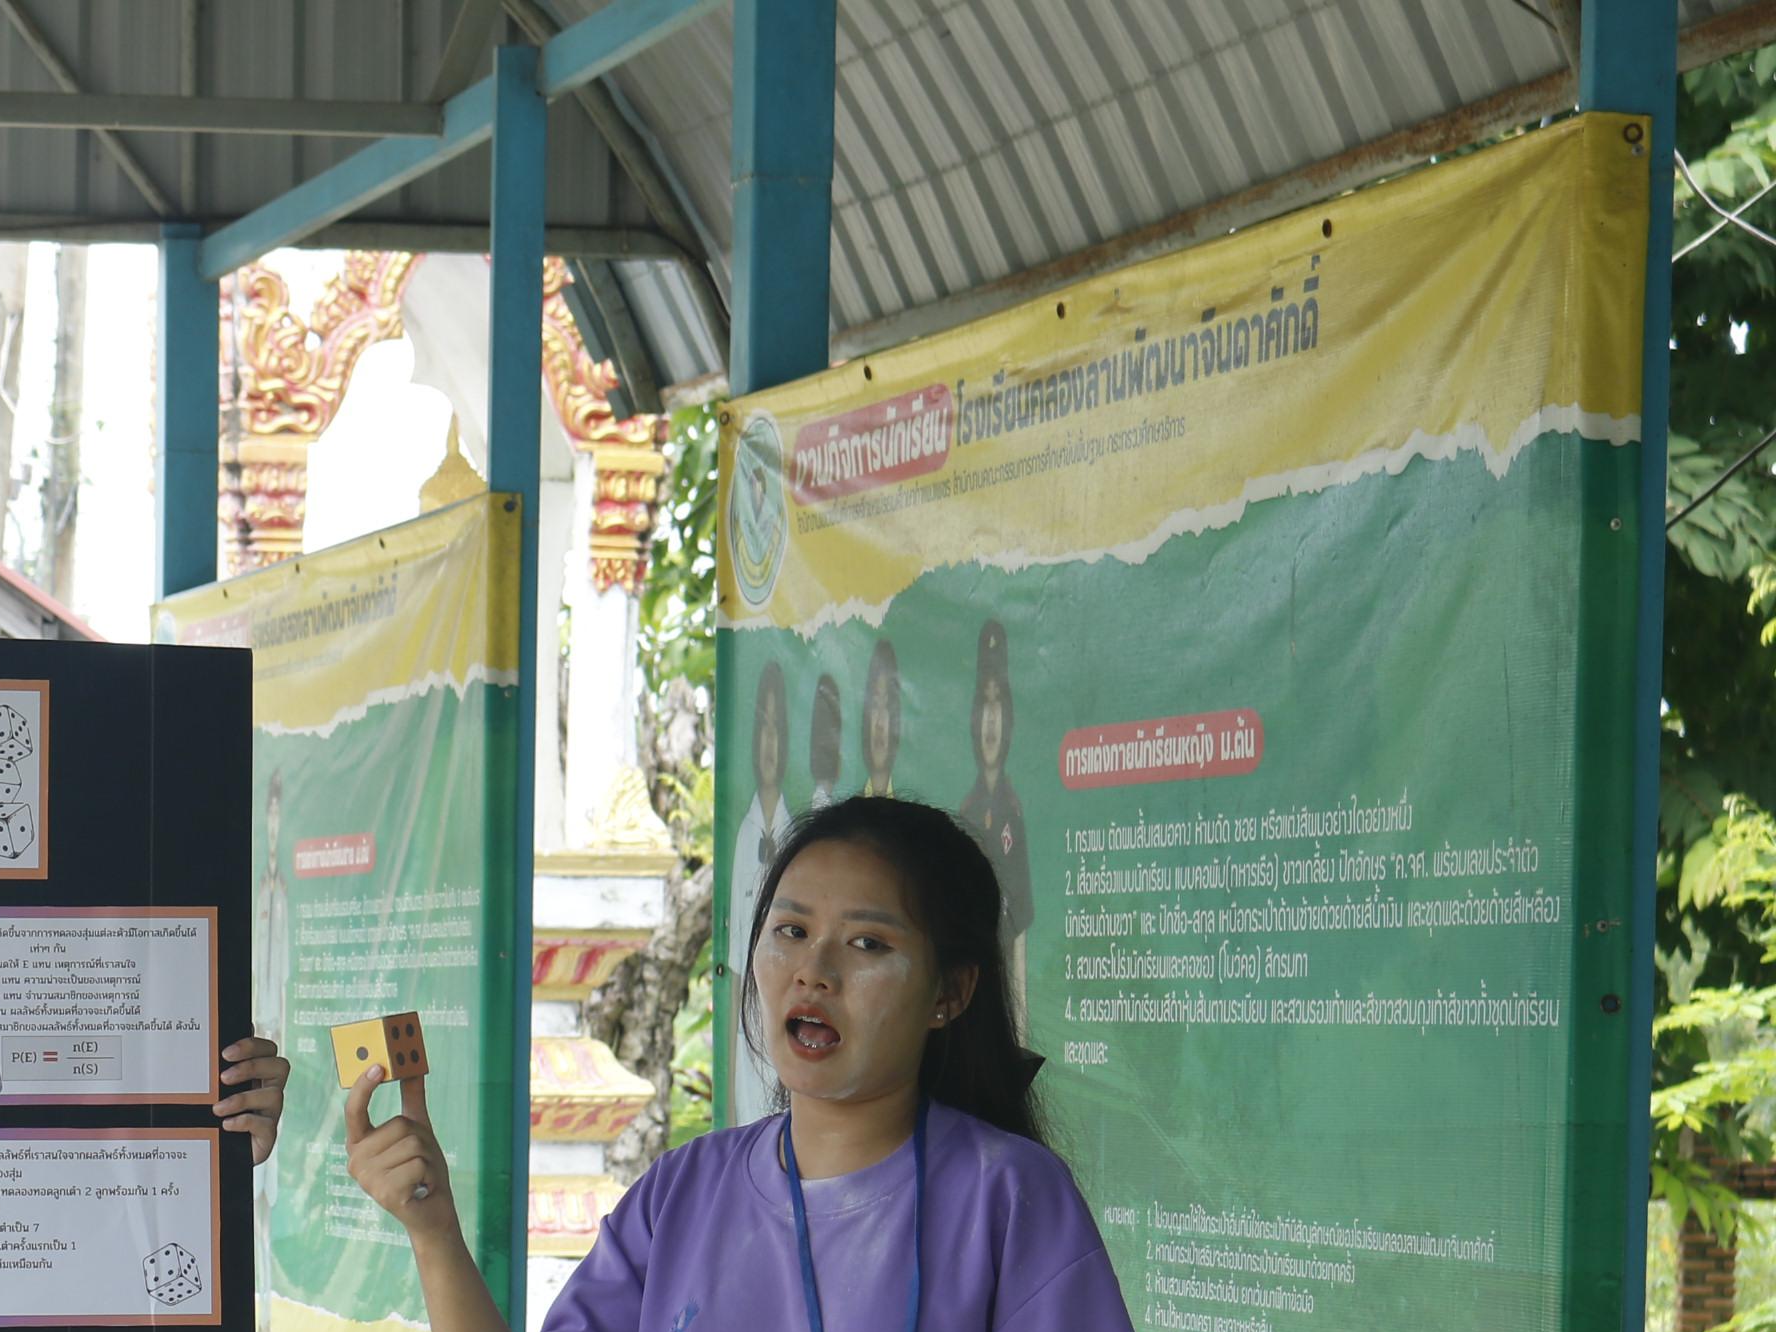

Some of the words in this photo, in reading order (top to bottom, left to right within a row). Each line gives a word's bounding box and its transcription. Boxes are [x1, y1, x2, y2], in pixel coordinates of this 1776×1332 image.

[795, 394, 949, 494] งานกิจการนักเรียน
[1221, 718, 1254, 760] ม.ต้น
[1066, 828, 1072, 853] 1.
[1075, 829, 1104, 853] ทรงผม
[1109, 808, 1191, 850] ตัดผมสั้นเสมอคาง
[1195, 812, 1230, 845] ห้ามดัด
[1235, 817, 1256, 842] ซอย
[1065, 870, 1073, 896] 2.
[1283, 845, 1334, 885] ขาวเกลี้ยง
[1339, 849, 1386, 886] ปักอักษร
[1433, 837, 1538, 877] พร้อมเลขประจำตัว
[1141, 912, 1156, 936] และ
[1160, 904, 1215, 942] ปักชื่อ-สกุล
[54, 943, 66, 952] กัน
[23, 960, 28, 968] E
[1066, 954, 1073, 980] 3.
[1219, 941, 1260, 984] (โบว์คอ)
[1265, 946, 1308, 978] สีกรมท่า
[176, 1019, 200, 1030] ดังนั้น
[12, 1052, 37, 1063] P(E)
[73, 1041, 98, 1053] n(E)
[1064, 1041, 1108, 1073] และชุดพละ
[73, 1064, 98, 1075] n(S)
[85, 1187, 91, 1196] 2
[96, 1185, 148, 1199] ลูกพร้อมกัน
[152, 1187, 156, 1195] 1
[161, 1182, 179, 1195] ครั้ง
